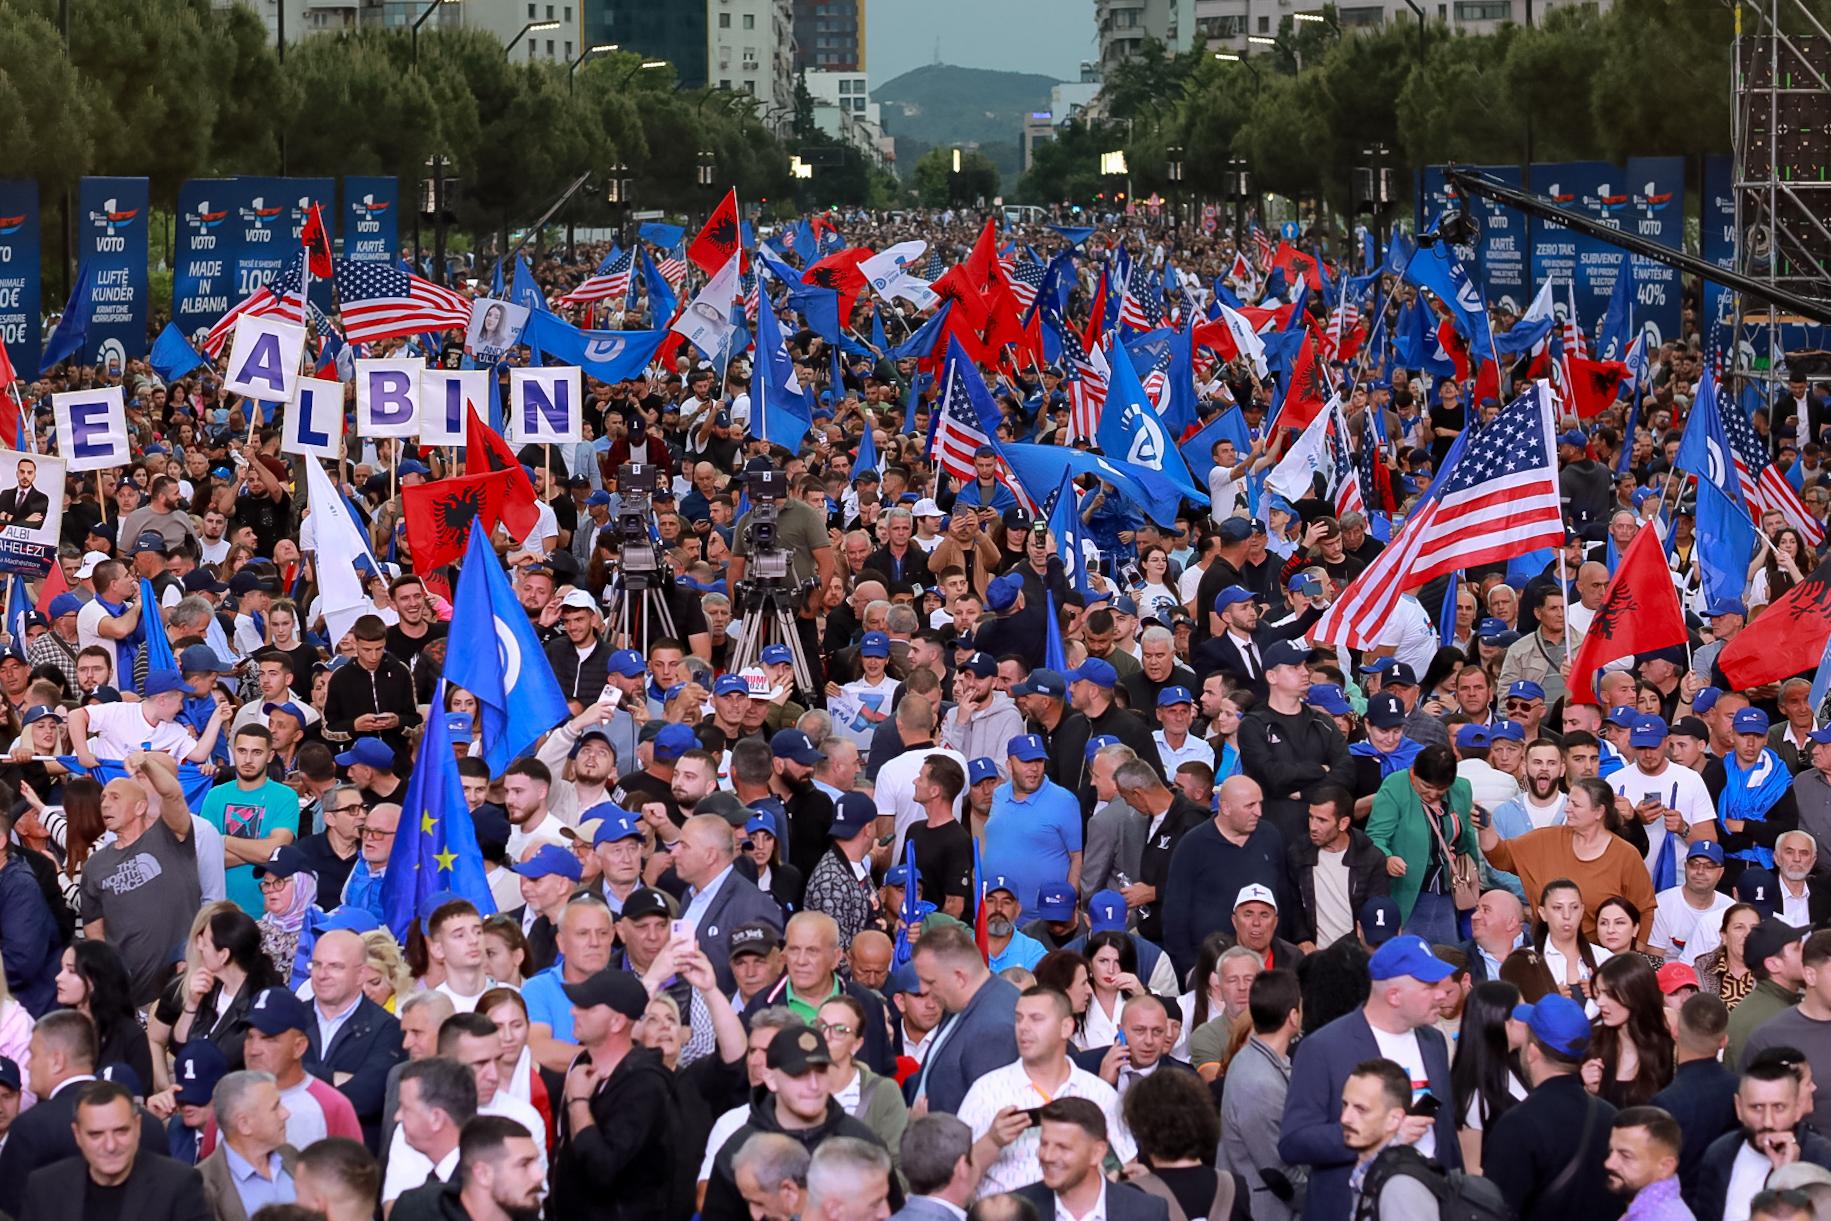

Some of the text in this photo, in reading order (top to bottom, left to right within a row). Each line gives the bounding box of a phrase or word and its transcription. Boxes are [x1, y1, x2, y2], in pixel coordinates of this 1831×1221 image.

[357, 221, 380, 232] VOTO
[1488, 216, 1508, 228] VOTO
[1638, 220, 1662, 235] VOTO
[245, 229, 272, 242] VOTO
[96, 237, 125, 252] VOTO
[190, 235, 216, 250] VOTO
[356, 238, 385, 252] KARTË
[1490, 236, 1515, 250] KARTË
[1536, 244, 1558, 256] ZERO
[188, 260, 222, 277] MADE
[1638, 267, 1662, 280] NAFTËS
[1662, 269, 1673, 280] ME
[0, 278, 25, 288] NIMALE
[97, 268, 129, 285] LUFTË
[92, 284, 134, 301] KUNDËR
[198, 278, 212, 295] IN
[1637, 283, 1666, 305] 40%
[96, 305, 116, 314] KRIMIT
[180, 296, 228, 314] ALBANIA
[235, 333, 285, 392] A
[368, 371, 414, 425] B
[445, 380, 460, 433] I
[522, 379, 569, 434] N
[297, 390, 329, 446] L
[633, 420, 639, 429] 1
[70, 402, 114, 458] E
[1017, 508, 1023, 519] 1
[1581, 511, 1587, 520] 1
[1251, 518, 1256, 526] 1
[5, 527, 30, 540] ALBI
[1303, 573, 1310, 582] 1
[1113, 597, 1119, 606] 1
[29, 610, 37, 619] 1
[960, 629, 968, 639] 1
[4, 647, 12, 655] 1
[971, 652, 980, 663] 1
[630, 653, 636, 663] 1
[1392, 664, 1400, 676] 1
[1177, 688, 1182, 697] 1
[1518, 682, 1524, 690] 1
[1335, 688, 1342, 699] 1
[1698, 689, 1706, 698] 1
[1389, 698, 1398, 712] 1
[1617, 707, 1624, 716] 1
[1502, 721, 1509, 730] 1
[803, 735, 812, 749] 1
[1028, 736, 1036, 747] 1
[1098, 738, 1105, 748] 1
[977, 759, 985, 770] 1
[836, 803, 844, 820] 1
[619, 818, 628, 830] 1
[1703, 841, 1710, 850] 1
[270, 847, 281, 861] 1
[116, 859, 137, 873] THE
[102, 866, 140, 890] NORTH
[997, 876, 1004, 886] 1
[113, 875, 143, 896] FACE
[1755, 886, 1764, 901] 1
[652, 893, 666, 908] 1
[1105, 906, 1113, 920] 1
[1376, 909, 1385, 926] 1
[254, 989, 270, 1009] 1
[103, 1066, 113, 1081] 1
[184, 1059, 196, 1079] 1
